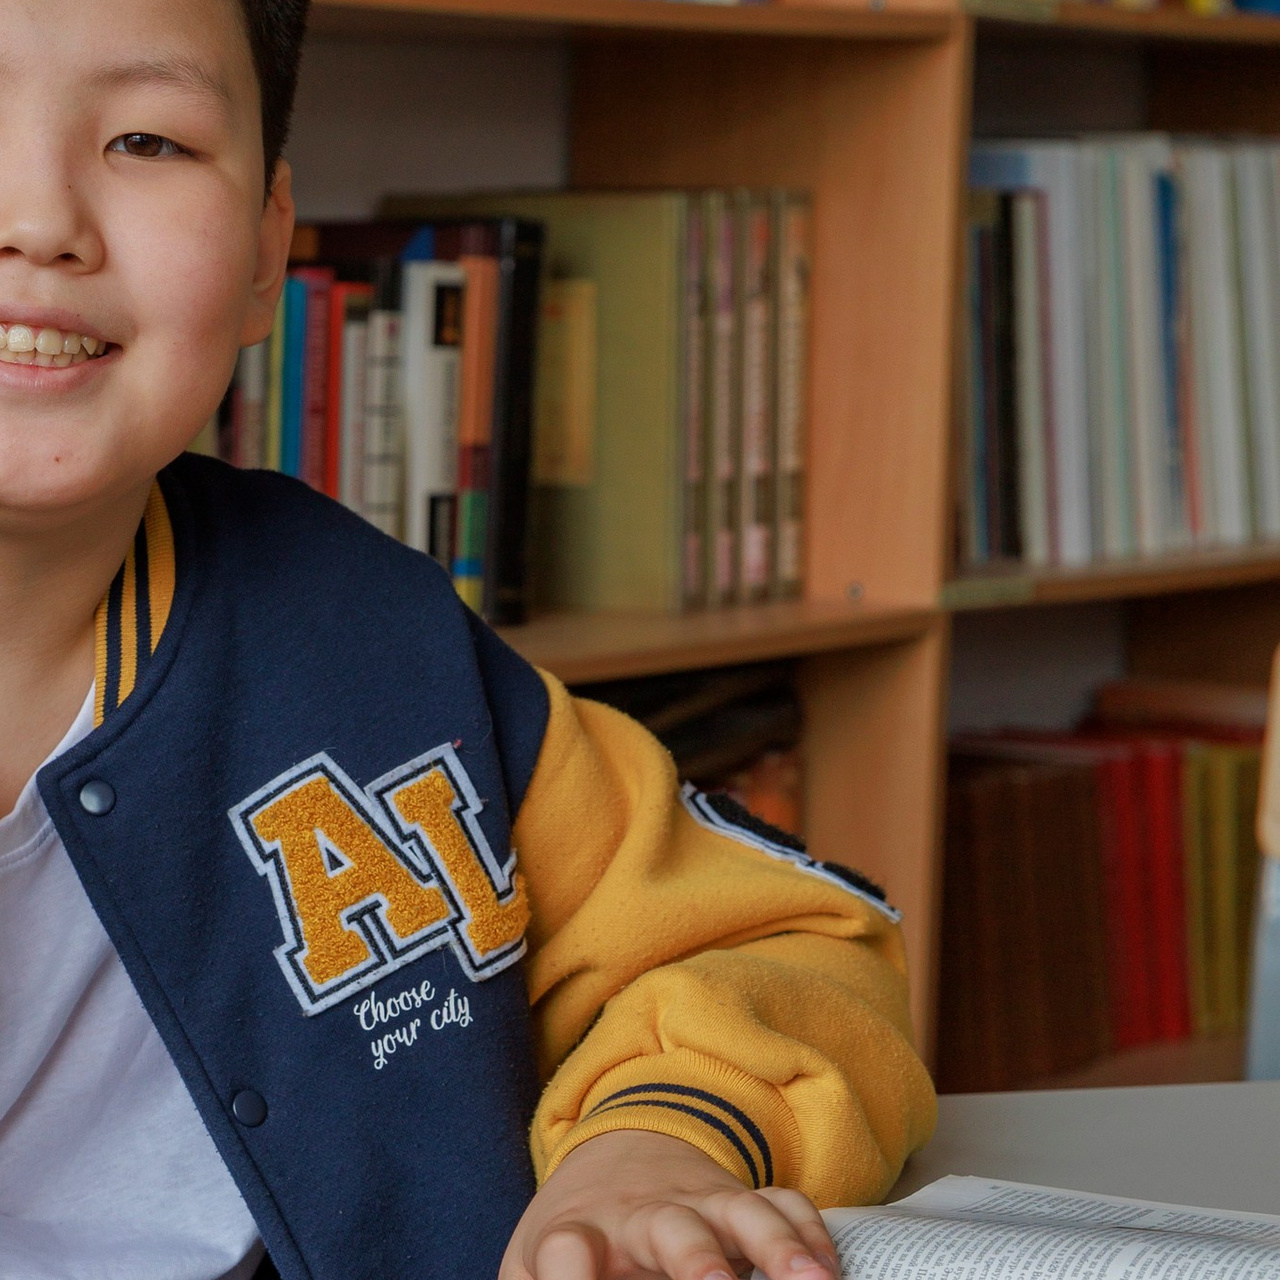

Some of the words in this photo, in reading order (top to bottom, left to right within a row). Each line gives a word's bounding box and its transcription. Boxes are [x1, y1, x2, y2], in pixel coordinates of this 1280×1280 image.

[353, 980, 435, 1031] Choose
[371, 1018, 420, 1070] your
[430, 988, 474, 1031] city
[854, 1256, 868, 1278] обра-
